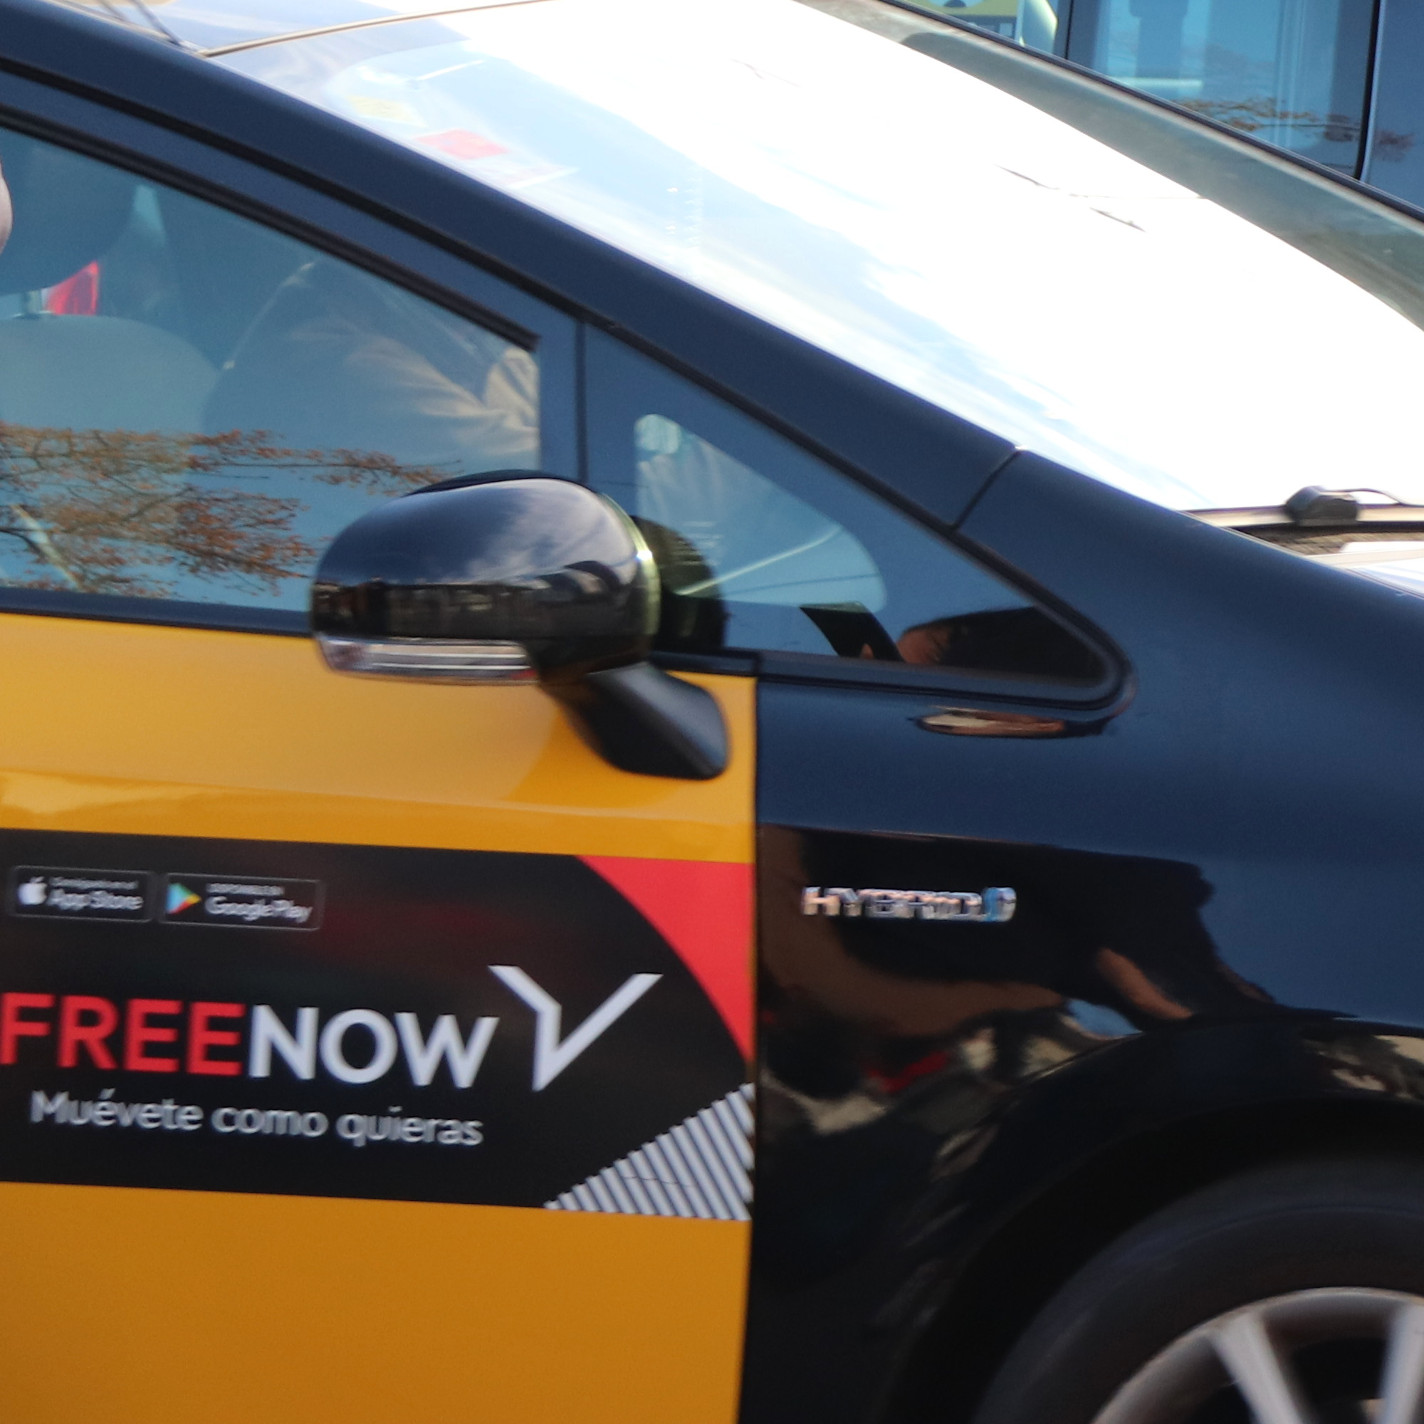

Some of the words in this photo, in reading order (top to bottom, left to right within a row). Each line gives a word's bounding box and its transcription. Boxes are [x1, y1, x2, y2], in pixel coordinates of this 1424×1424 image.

[205, 895, 274, 922] Google
[271, 899, 314, 923] Play
[801, 886, 983, 922] HYBRID
[30, 1088, 203, 1131] Muévete
[211, 1106, 328, 1138] como
[336, 1106, 484, 1147] quieras
